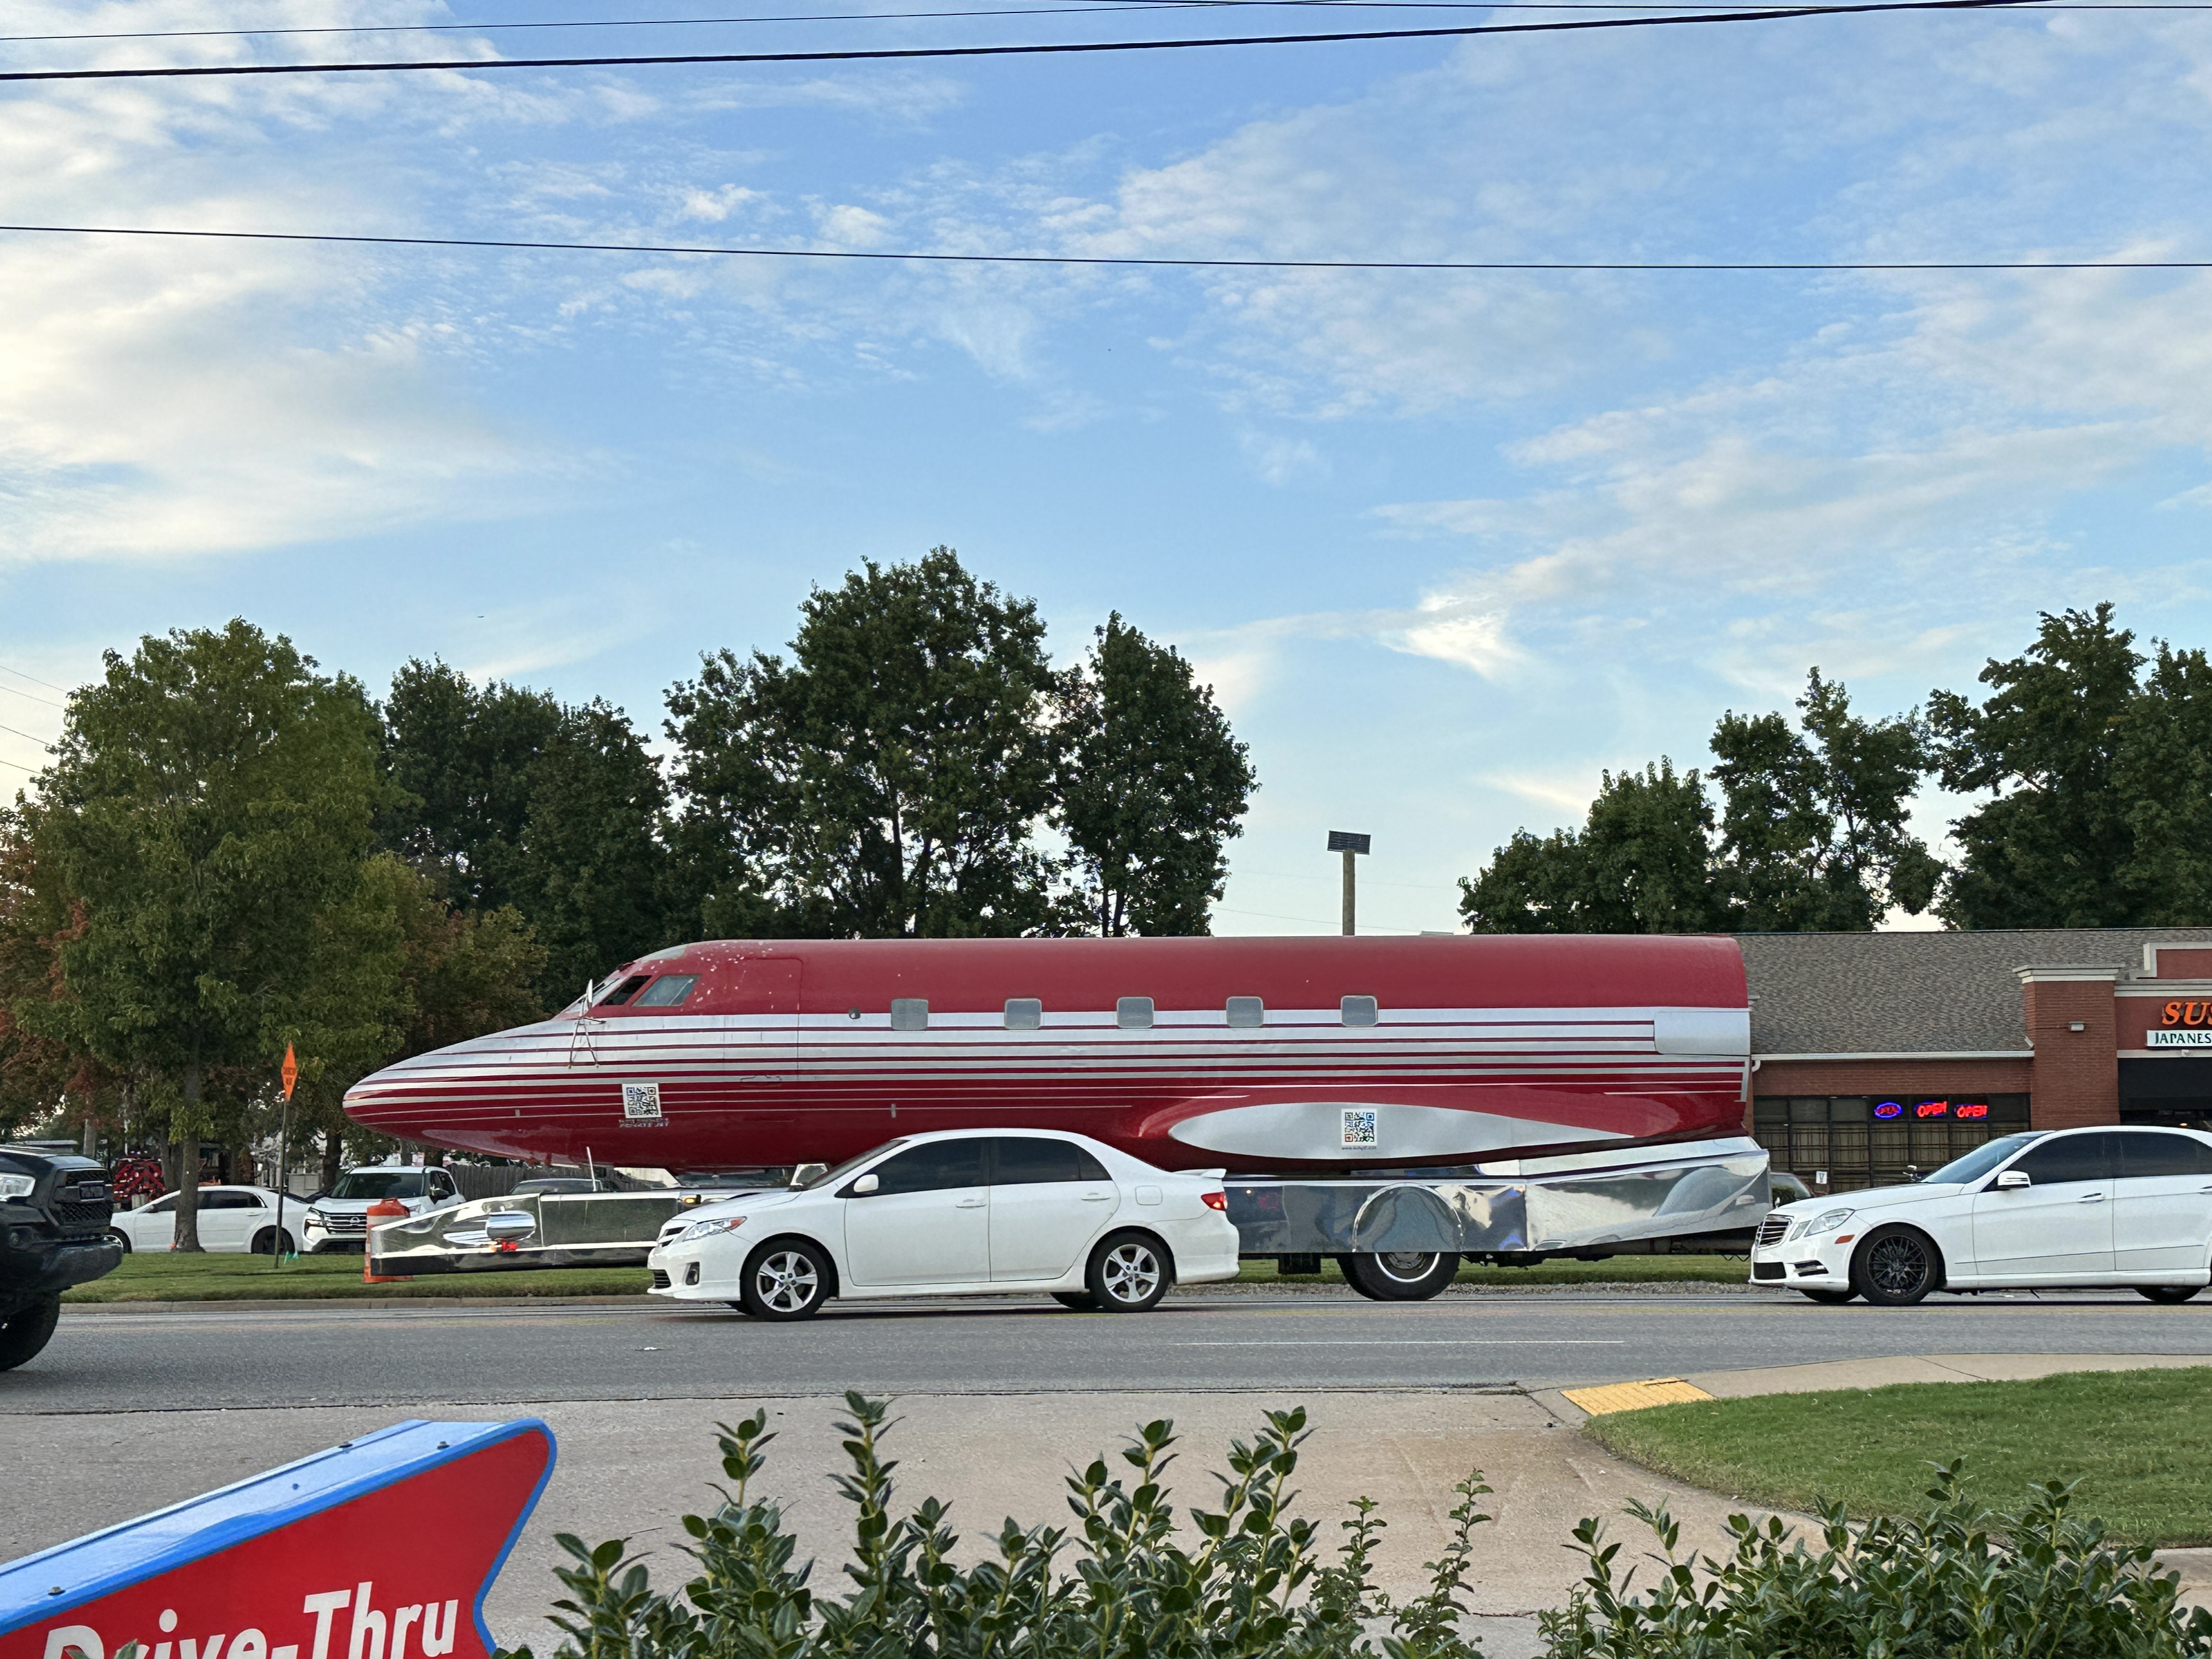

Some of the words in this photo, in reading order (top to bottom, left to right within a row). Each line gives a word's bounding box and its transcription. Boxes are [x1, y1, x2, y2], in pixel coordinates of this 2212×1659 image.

[2155, 1032, 2211, 1044] JAPANES
[1917, 1101, 1947, 1117] OPEN
[1957, 1106, 1987, 1117] OPEN
[44, 1581, 458, 1659] ie-Thru
